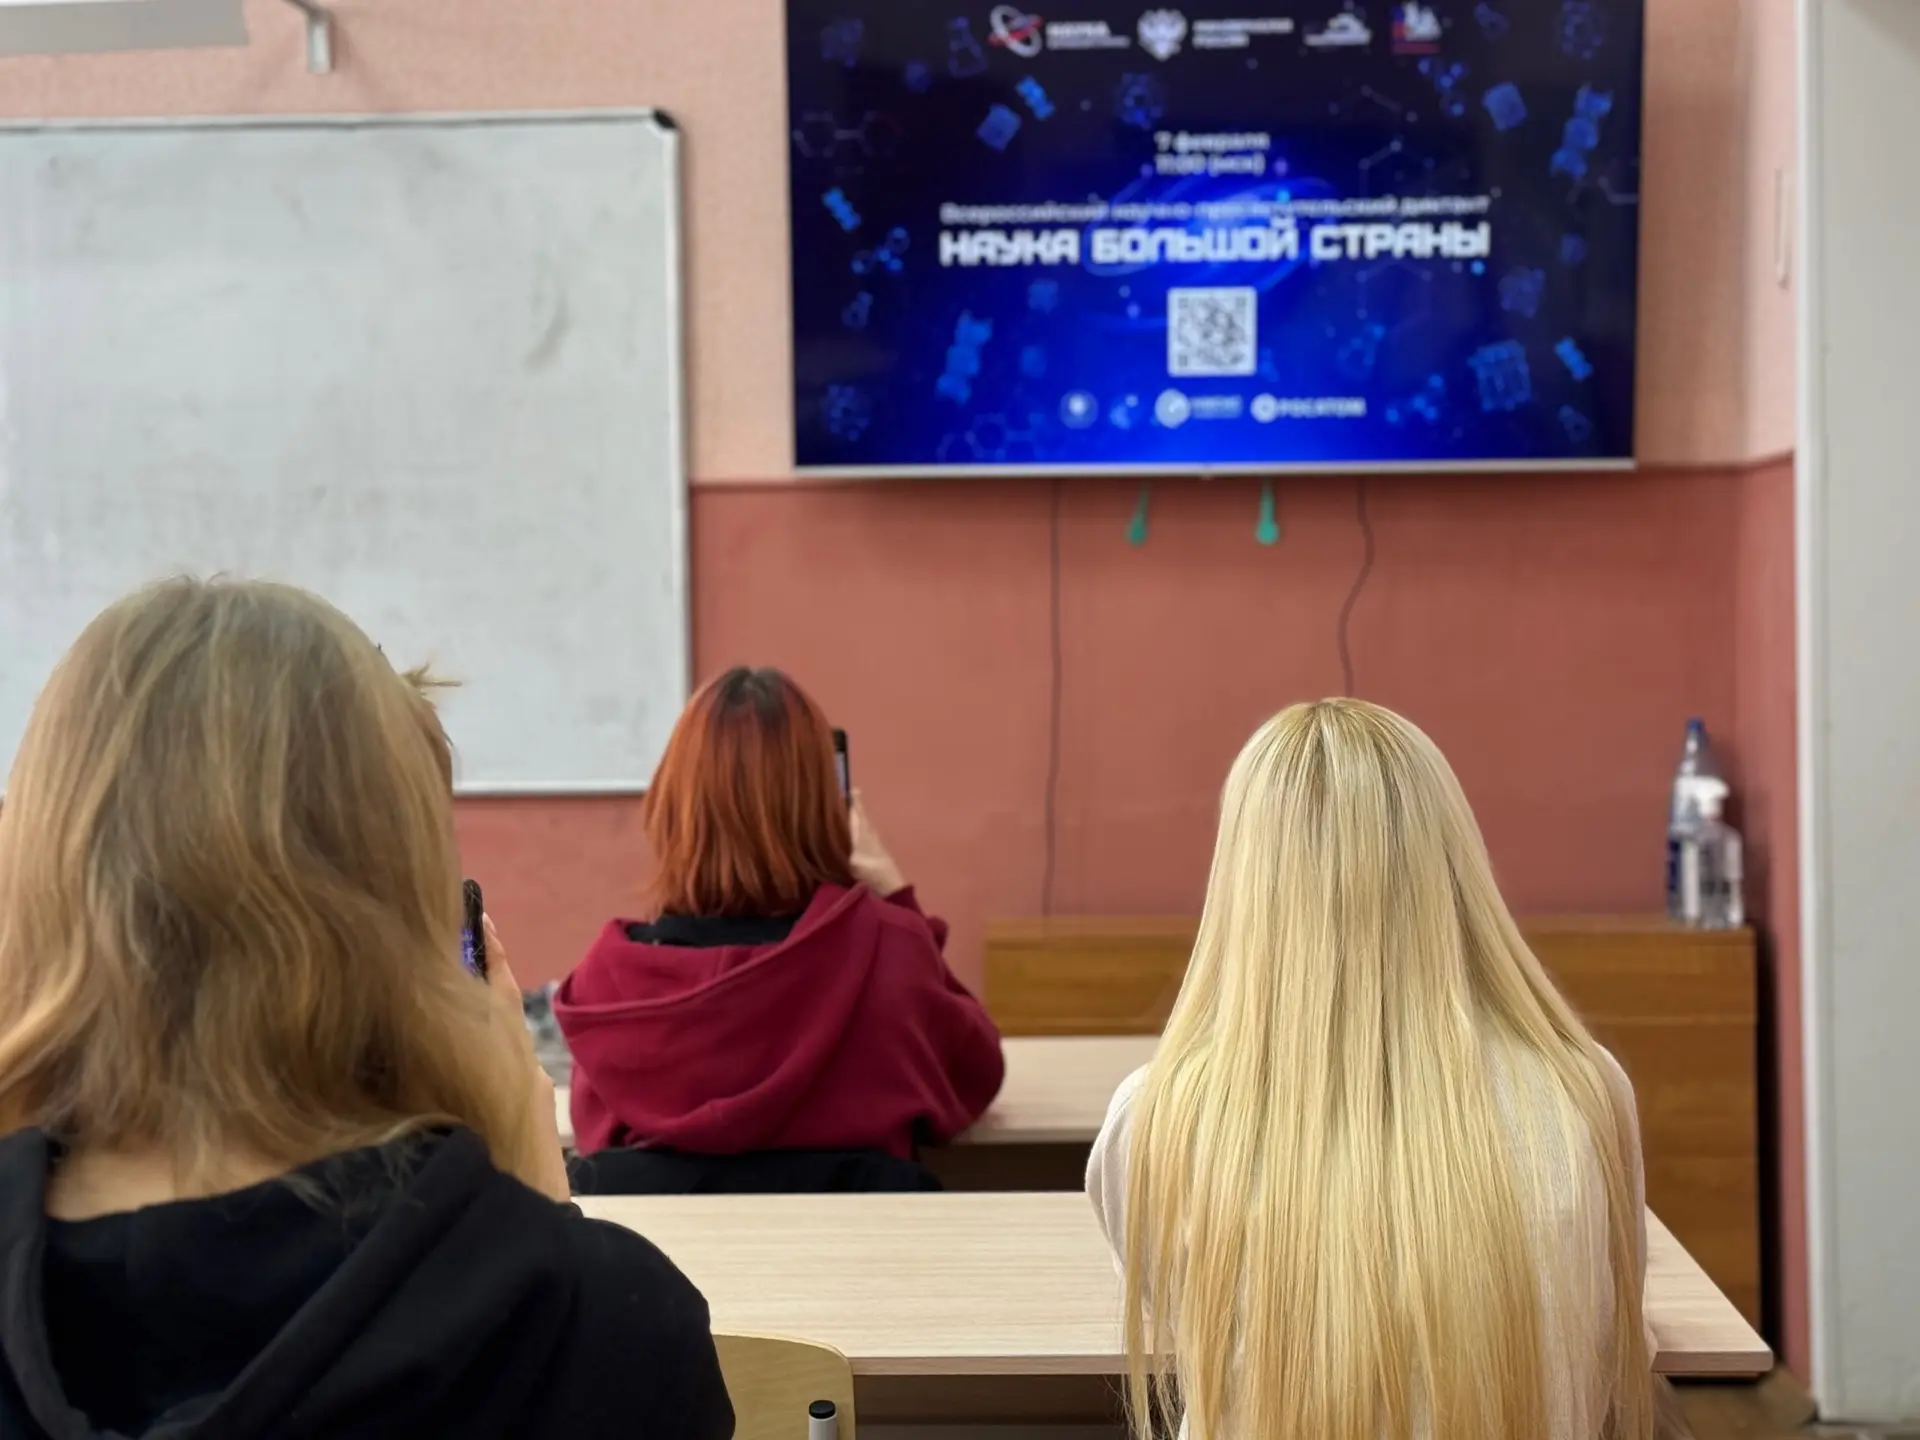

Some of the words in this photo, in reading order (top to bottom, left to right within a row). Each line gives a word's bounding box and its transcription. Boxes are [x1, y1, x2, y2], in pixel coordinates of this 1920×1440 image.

[940, 230, 1079, 265] НАУКА
[1092, 217, 1297, 263] БОЛЬШОЙ
[1311, 222, 1489, 259] СТРАНЫ
